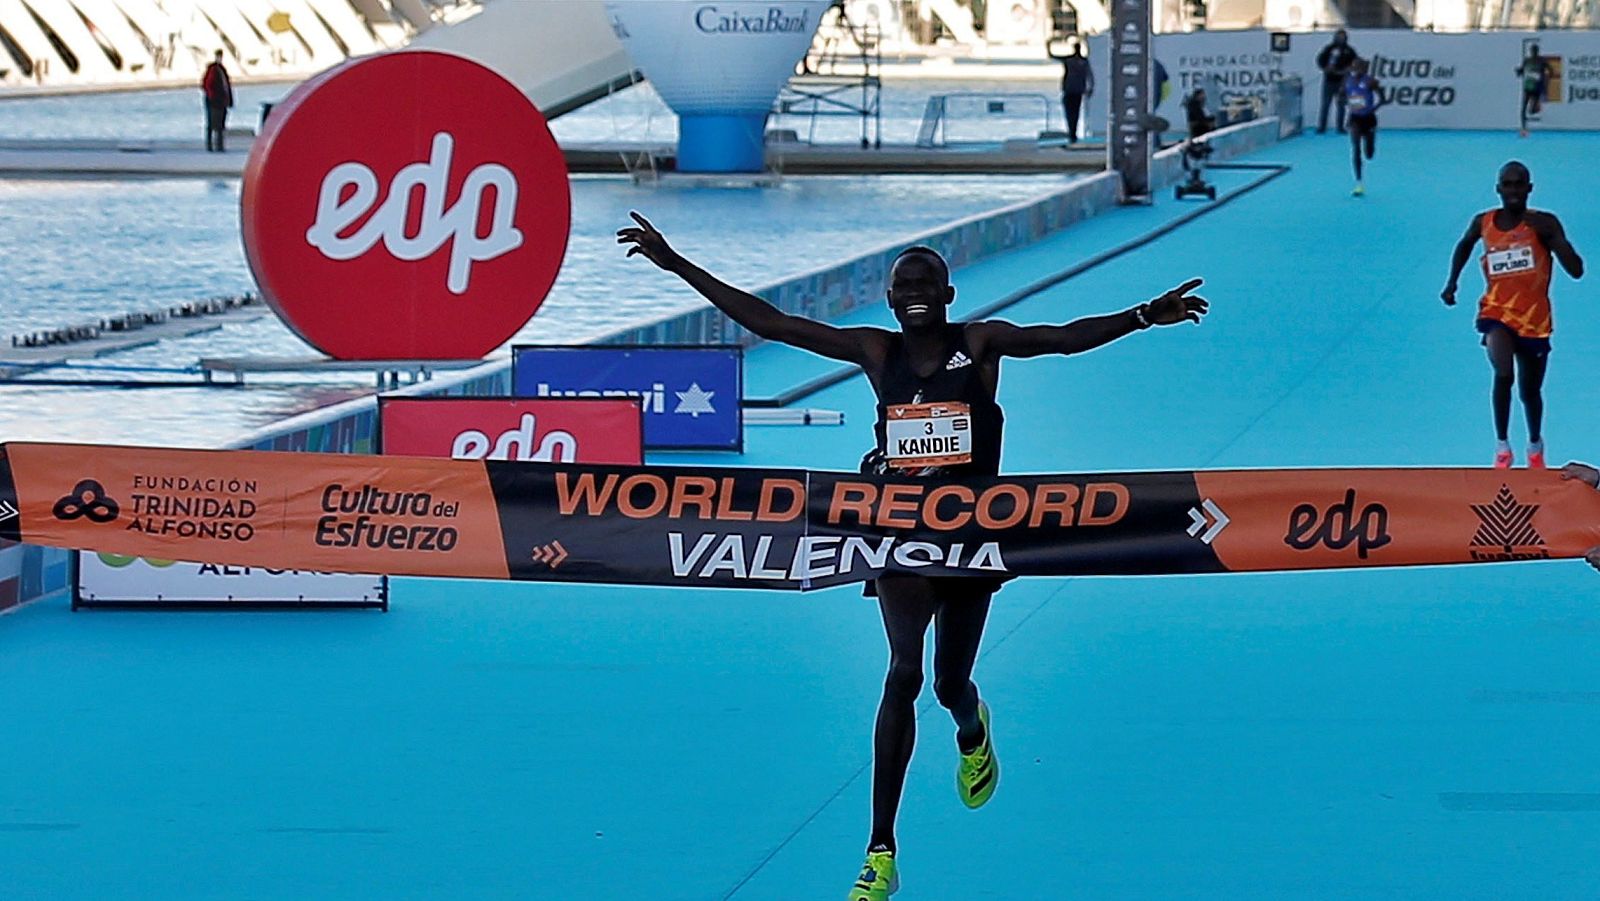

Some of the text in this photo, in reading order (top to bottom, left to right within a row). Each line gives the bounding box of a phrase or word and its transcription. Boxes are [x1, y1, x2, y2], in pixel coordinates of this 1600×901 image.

[695, 7, 808, 34] CaixaBank
[306, 131, 524, 294] edp
[924, 422, 934, 435] 3
[898, 436, 960, 455] KANDIE
[133, 475, 258, 494] FUNDACIÓN
[131, 494, 257, 520] TRINIDAD
[321, 484, 459, 518] Cultura del
[554, 472, 1131, 530] WORLD RECORD
[126, 517, 255, 542] ALFONSO
[315, 515, 458, 552] Esfuerzo
[1283, 488, 1392, 560] edp
[667, 532, 1008, 581] VALENCIA
